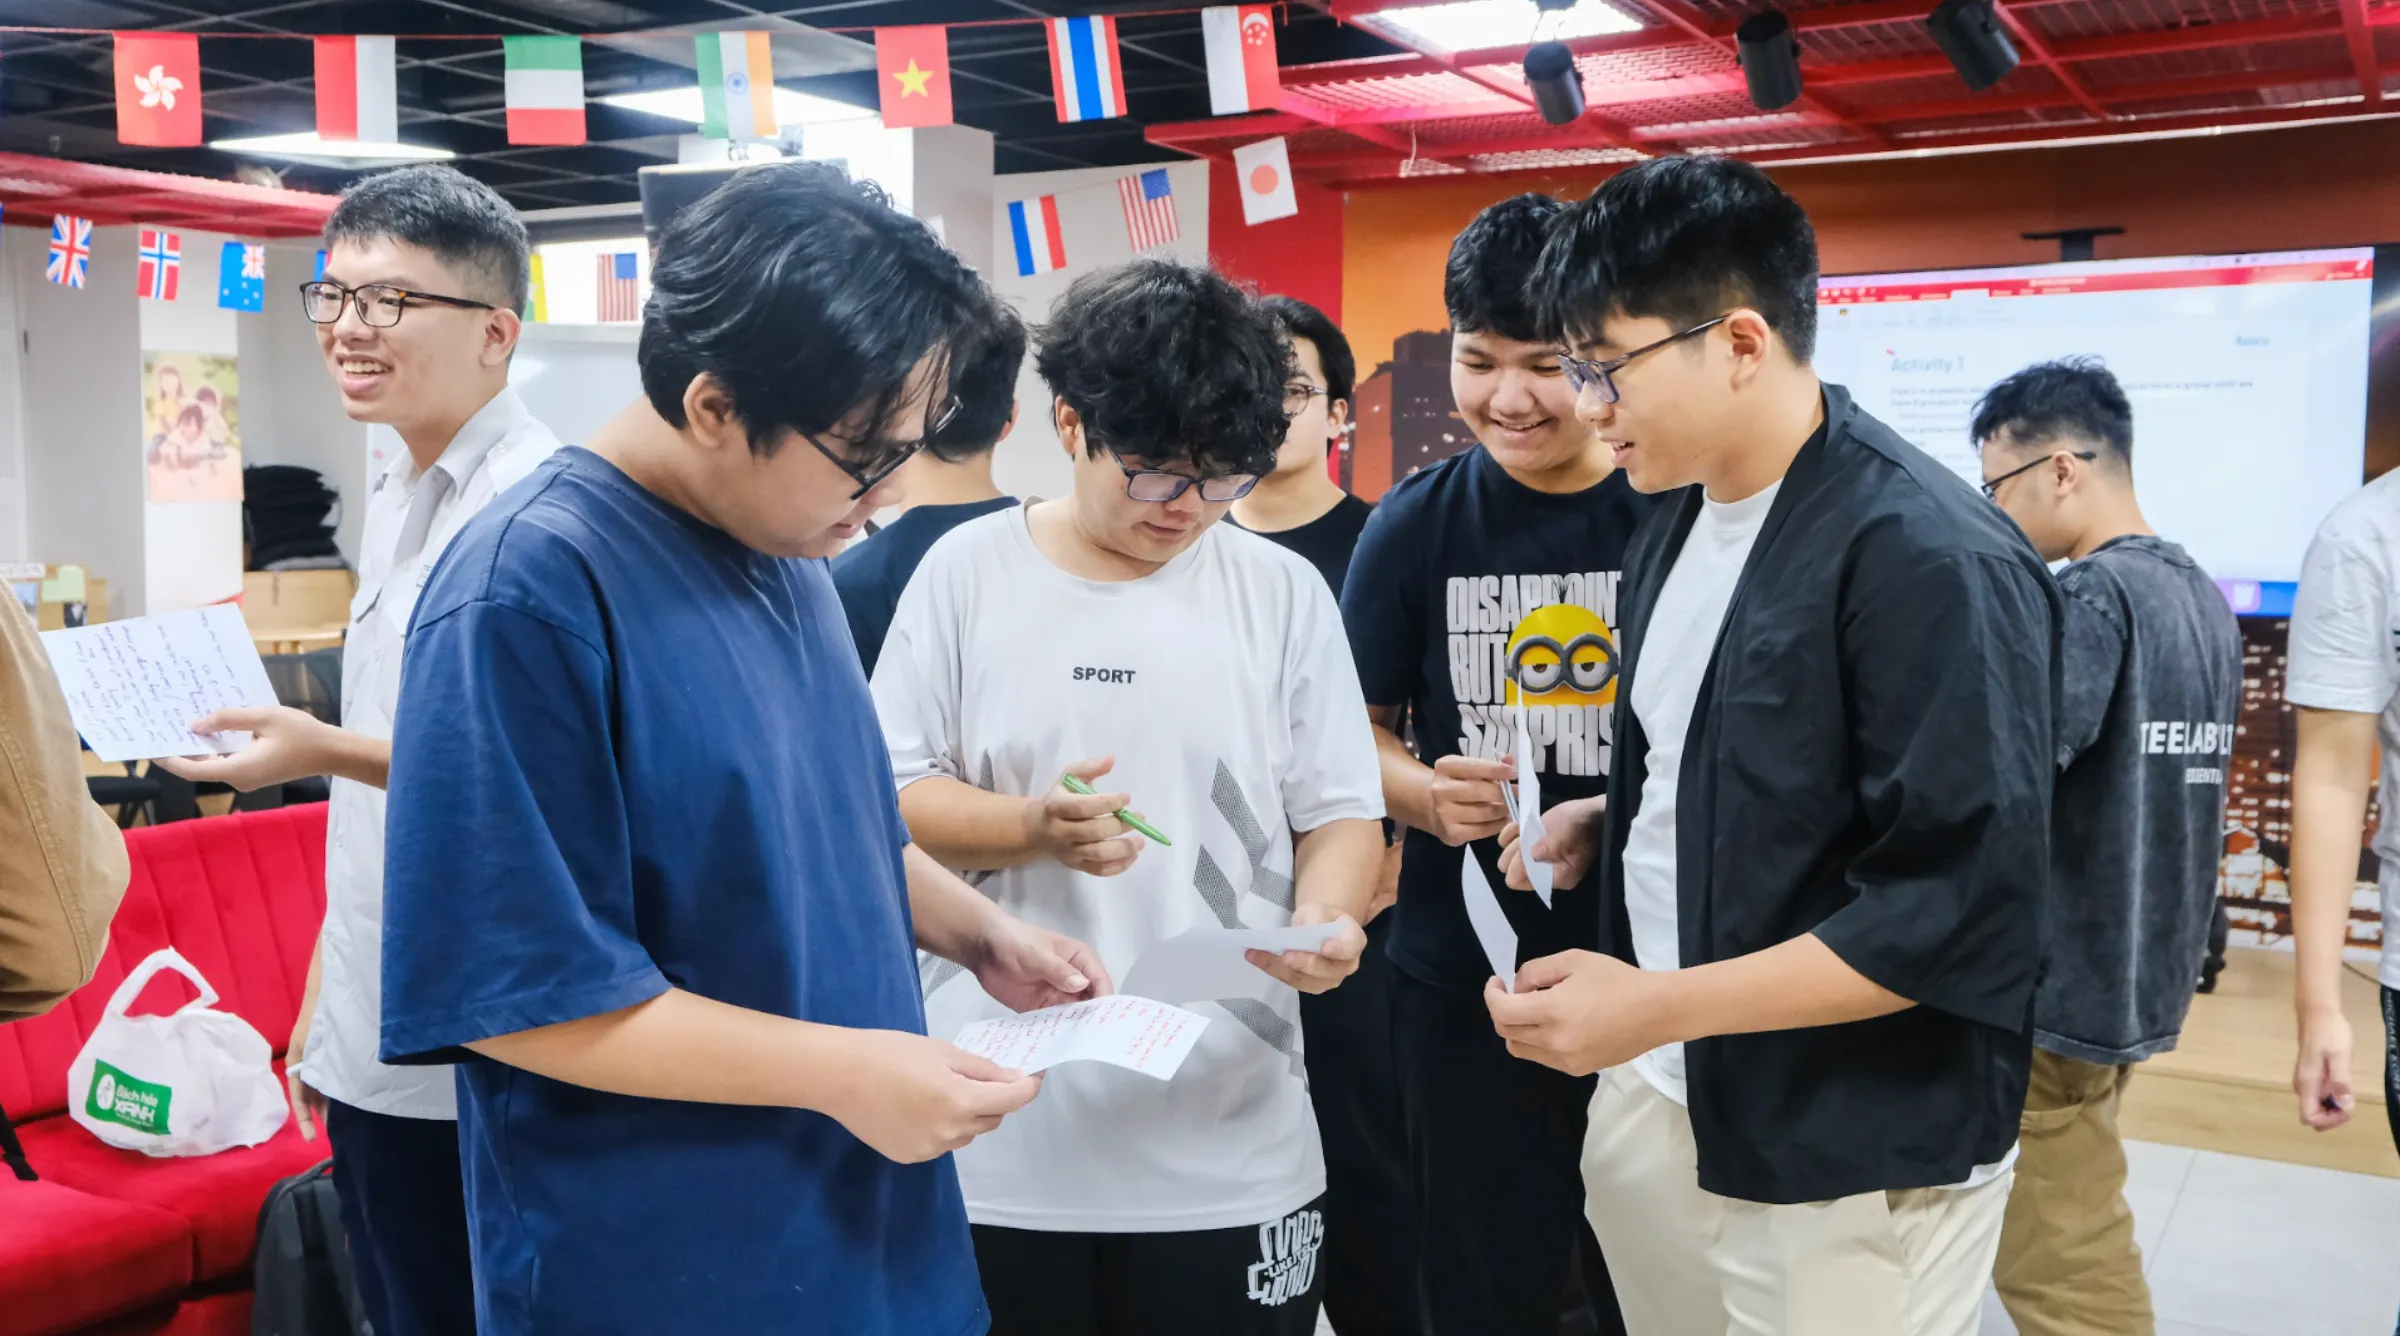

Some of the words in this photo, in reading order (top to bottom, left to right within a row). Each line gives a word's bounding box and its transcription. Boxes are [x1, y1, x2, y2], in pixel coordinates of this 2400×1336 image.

[1891, 357, 1954, 375] Activity
[1446, 571, 1622, 634] DISAPPOIN
[1072, 666, 1136, 684] SPORT
[1447, 633, 1508, 704] BUT
